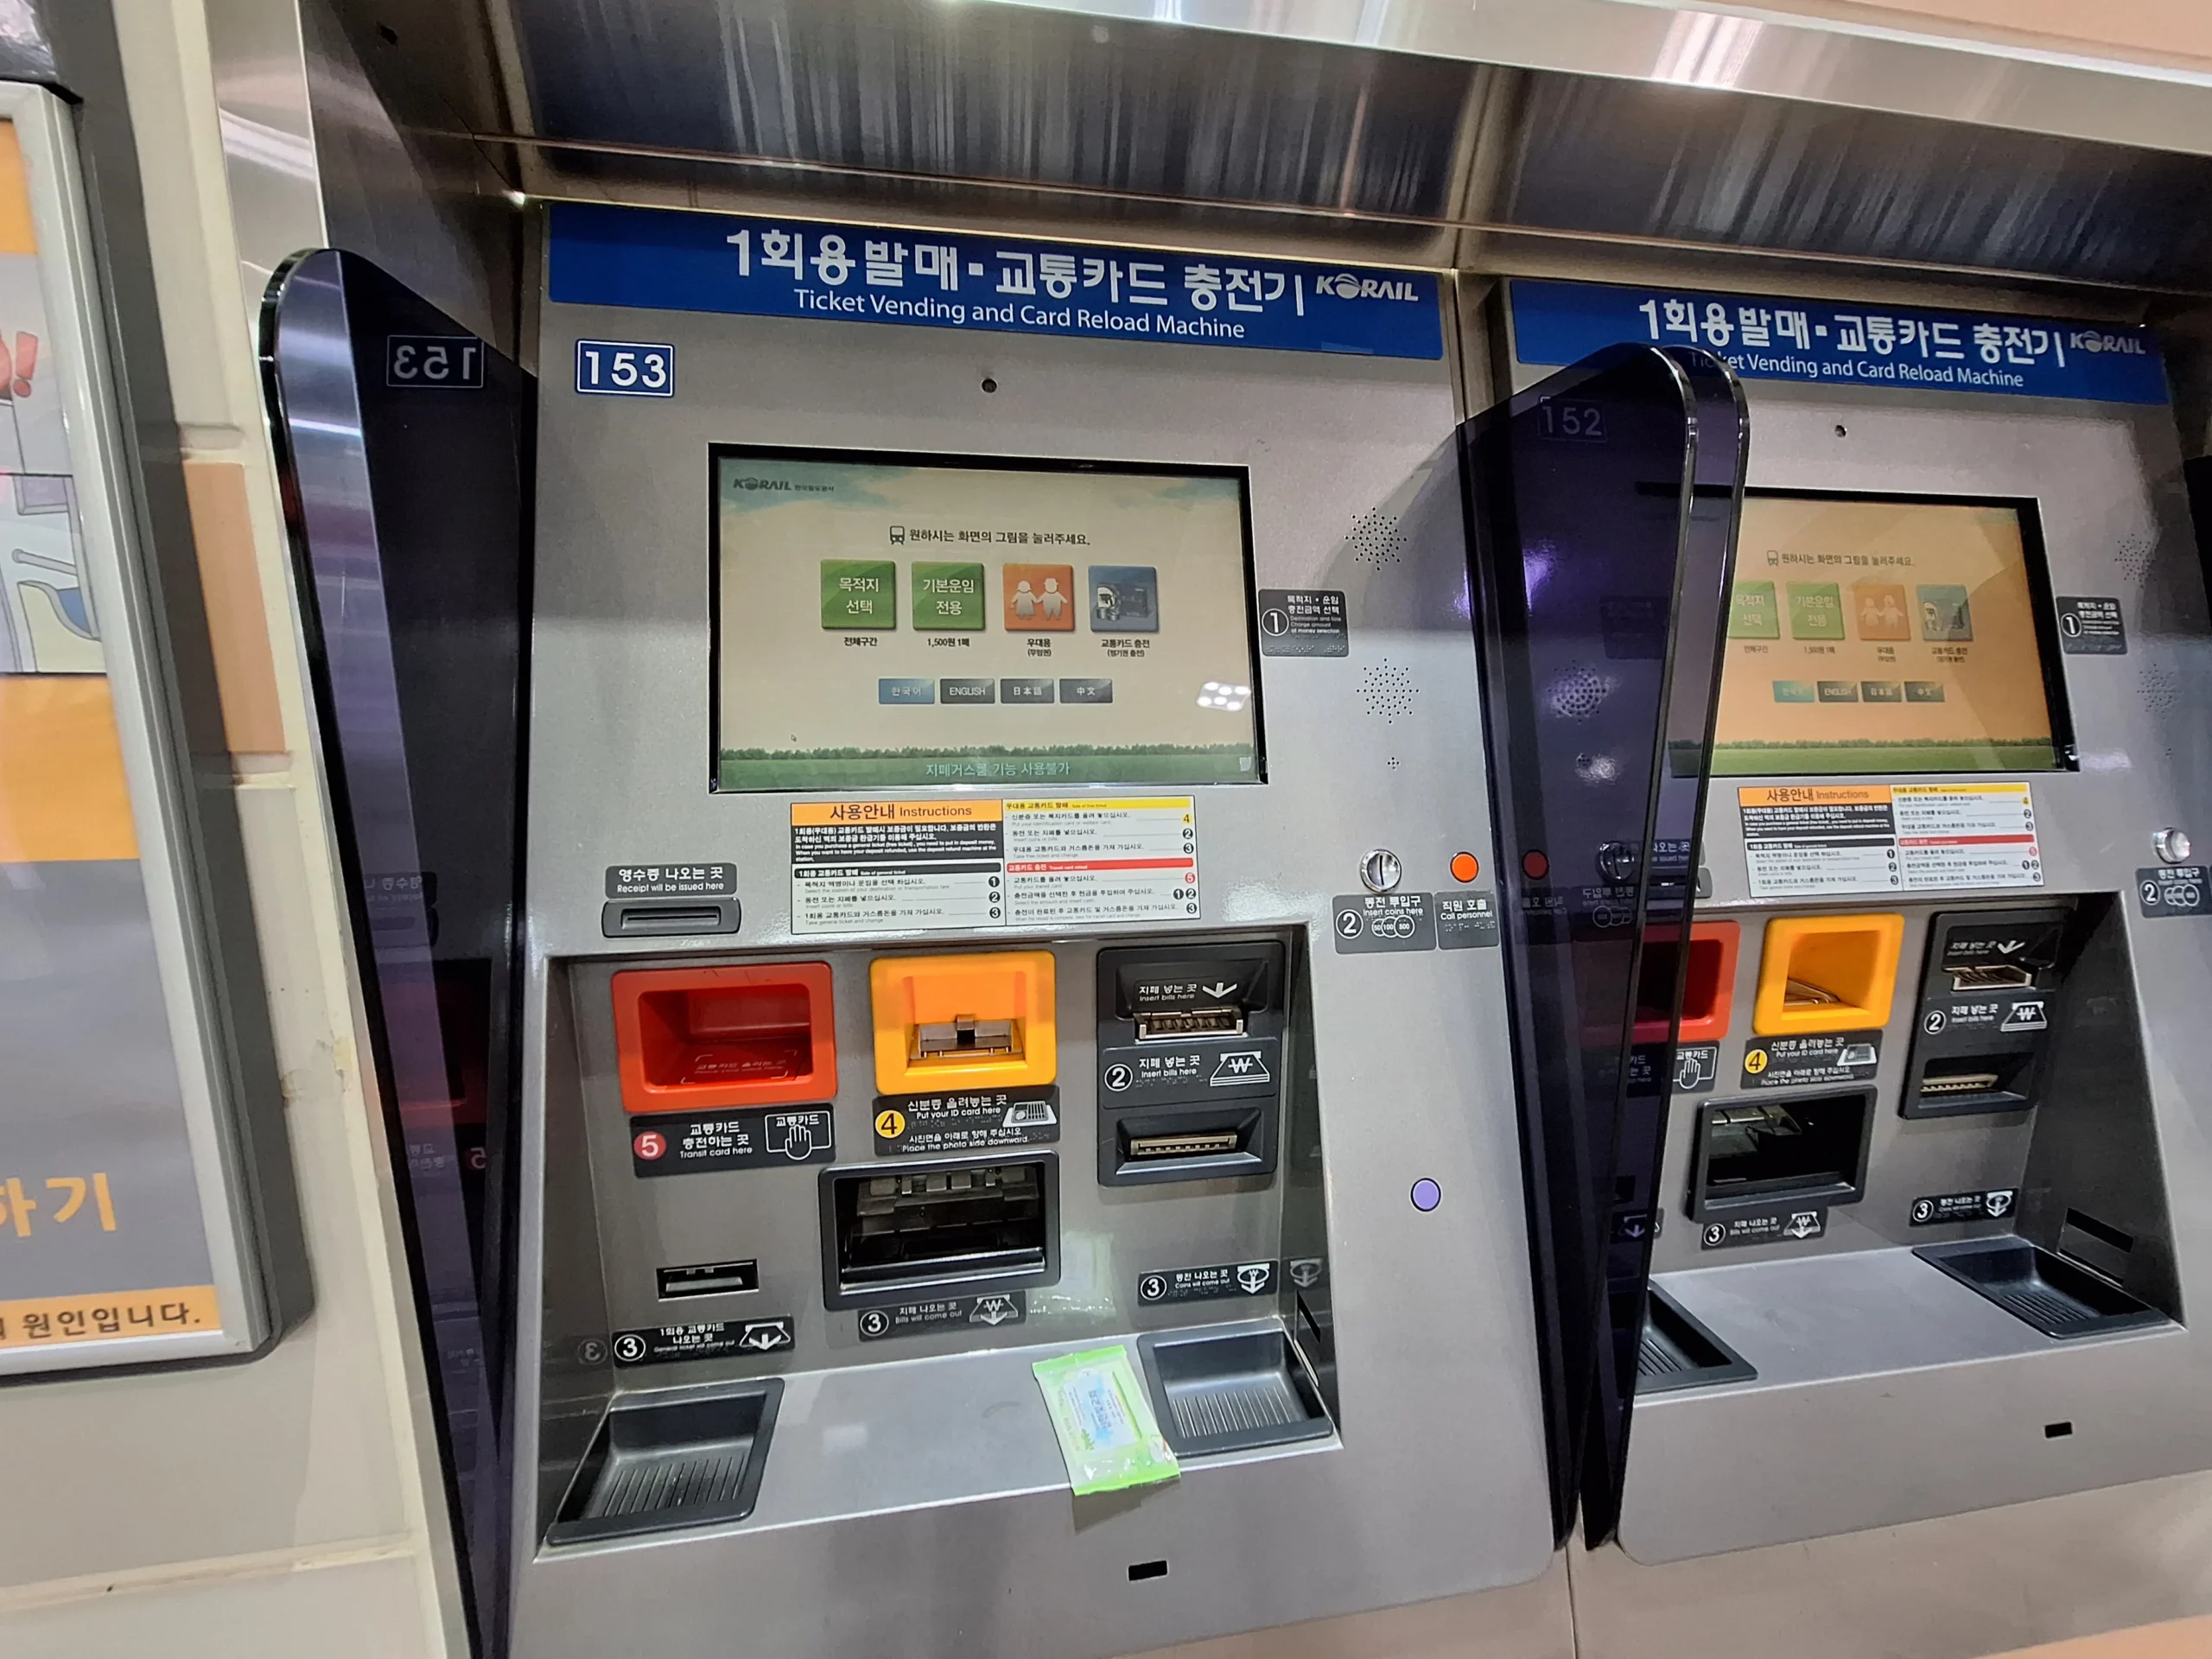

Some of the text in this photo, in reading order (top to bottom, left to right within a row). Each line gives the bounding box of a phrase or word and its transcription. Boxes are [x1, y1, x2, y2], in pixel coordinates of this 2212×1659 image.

[1184, 263, 1305, 316] 충전기
[1315, 273, 1419, 302] KORAIL
[794, 289, 1244, 339] Ticket Vending and Card Reload Machine
[1973, 321, 2065, 368] 충전기
[2070, 331, 2146, 356] KORAIL
[584, 350, 667, 389] 153
[1746, 353, 2024, 387] Vending and Card Reload Machine
[1541, 405, 1602, 435] 152
[733, 477, 791, 491] KORAIL
[909, 529, 1090, 546] 원하시는 화면의 그림을 눌러주세요.
[839, 578, 880, 593] 목적지
[923, 579, 975, 594] 기본운임
[1287, 594, 1339, 605] 목적지 운임
[846, 600, 873, 615] 선택
[936, 601, 963, 615] 전용
[1323, 606, 1339, 615] 선택
[843, 637, 878, 648] 전체구간
[927, 638, 956, 648] 1,500원
[1027, 639, 1051, 648] 우대용
[1101, 639, 1134, 648] 교통카드
[891, 686, 923, 698] 한국어
[950, 687, 987, 696] ENGLISH
[1013, 687, 1042, 696] 日本語
[1077, 687, 1096, 696] 中文
[994, 762, 1018, 776] 기능
[1021, 761, 1071, 776] 사용불가
[1766, 788, 1870, 802] 사용안내 Instructions
[830, 803, 973, 821] 사용안내 Instructions
[619, 867, 724, 883] 영수증 나오는 곳
[617, 884, 650, 893] Receipt
[651, 883, 664, 892] will
[664, 883, 676, 892] be
[678, 882, 703, 892] issued
[2145, 883, 2157, 902] 2
[1364, 895, 1422, 909] 동전 투입구
[1442, 899, 1488, 912] 직원 호출
[1363, 908, 1382, 918] Insert
[1406, 907, 1424, 916] here
[1440, 911, 1493, 921] Call personnel
[1343, 912, 1357, 935] 2
[1139, 983, 1198, 995] 지폐 넣는 곳
[1929, 1013, 1941, 1032] 2
[1824, 1047, 1839, 1056] here
[1139, 1054, 1201, 1070] 지폐 넣는 곳
[1749, 1052, 1761, 1071] 4
[1111, 1067, 1125, 1087] 2
[1179, 1067, 1198, 1077] here
[907, 1094, 1007, 1113] 신분증 올려놓는 곳
[775, 1114, 821, 1127] 교통카드
[916, 1111, 930, 1120] Put
[931, 1111, 949, 1120] your
[950, 1109, 959, 1118] ID
[961, 1108, 980, 1116] card
[690, 1122, 741, 1135] 교통카드
[880, 1113, 899, 1135] 4
[989, 1127, 1021, 1137] 주십시오
[641, 1135, 658, 1158] 5
[682, 1134, 750, 1149] 충전하는 곳
[902, 1136, 1030, 1153] Place the photo side downward.
[680, 1147, 753, 1160] Transit card here
[1917, 1202, 1929, 1218] 3
[1708, 1226, 1719, 1243] 3
[1176, 1272, 1192, 1282] 동전
[1194, 1270, 1218, 1281] 나오는
[1220, 1277, 1230, 1286] out
[1147, 1278, 1160, 1298] 3
[919, 1304, 945, 1313] 나오는
[22, 1301, 200, 1339] 원인입니다.
[868, 1313, 881, 1332] 3
[895, 1316, 909, 1325] Bills
[924, 1313, 947, 1322] come
[950, 1310, 963, 1319] out
[673, 1334, 702, 1344] 나오는
[622, 1338, 638, 1358] 3
